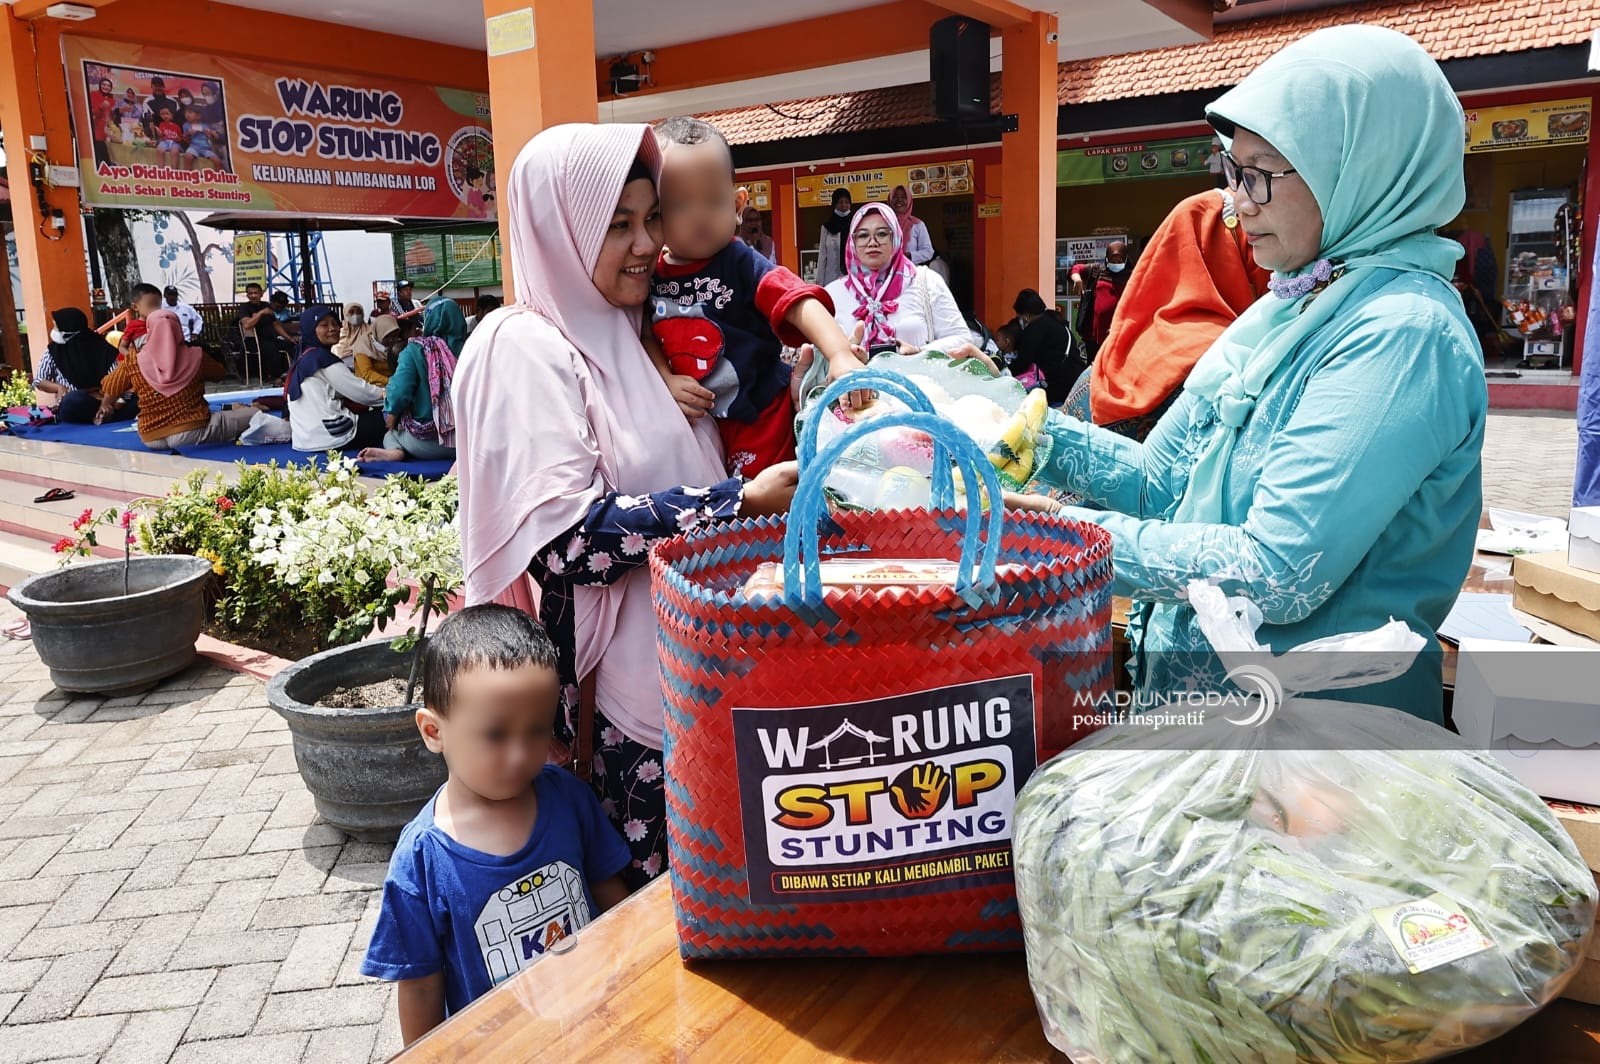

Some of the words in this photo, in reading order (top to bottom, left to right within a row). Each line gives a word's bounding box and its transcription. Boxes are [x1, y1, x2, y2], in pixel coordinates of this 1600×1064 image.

[277, 78, 402, 125] WARUNG
[238, 115, 314, 156] STOP
[317, 126, 441, 166] STUNTING
[98, 163, 129, 180] Ayo
[132, 165, 200, 184] Didukung
[252, 164, 332, 185] KELURAHAN
[334, 171, 412, 190] NAMBANGAN
[415, 175, 436, 191] LOR
[823, 175, 845, 185] SRITI
[847, 172, 872, 183] INDAH
[873, 171, 883, 180] 02
[100, 183, 132, 196] Anak
[134, 184, 166, 197] Sehat
[170, 187, 205, 199] Bebas
[207, 189, 251, 203] Stunting
[1070, 242, 1095, 251] JUAL
[780, 810, 1006, 859] STUNTING
[781, 875, 829, 889] DIBAWA
[831, 872, 872, 888] SETIAP
[875, 868, 901, 884] KALI
[904, 858, 973, 881] MENGAMBIL
[975, 851, 1010, 870] PAKET
[521, 913, 573, 960] KAI
